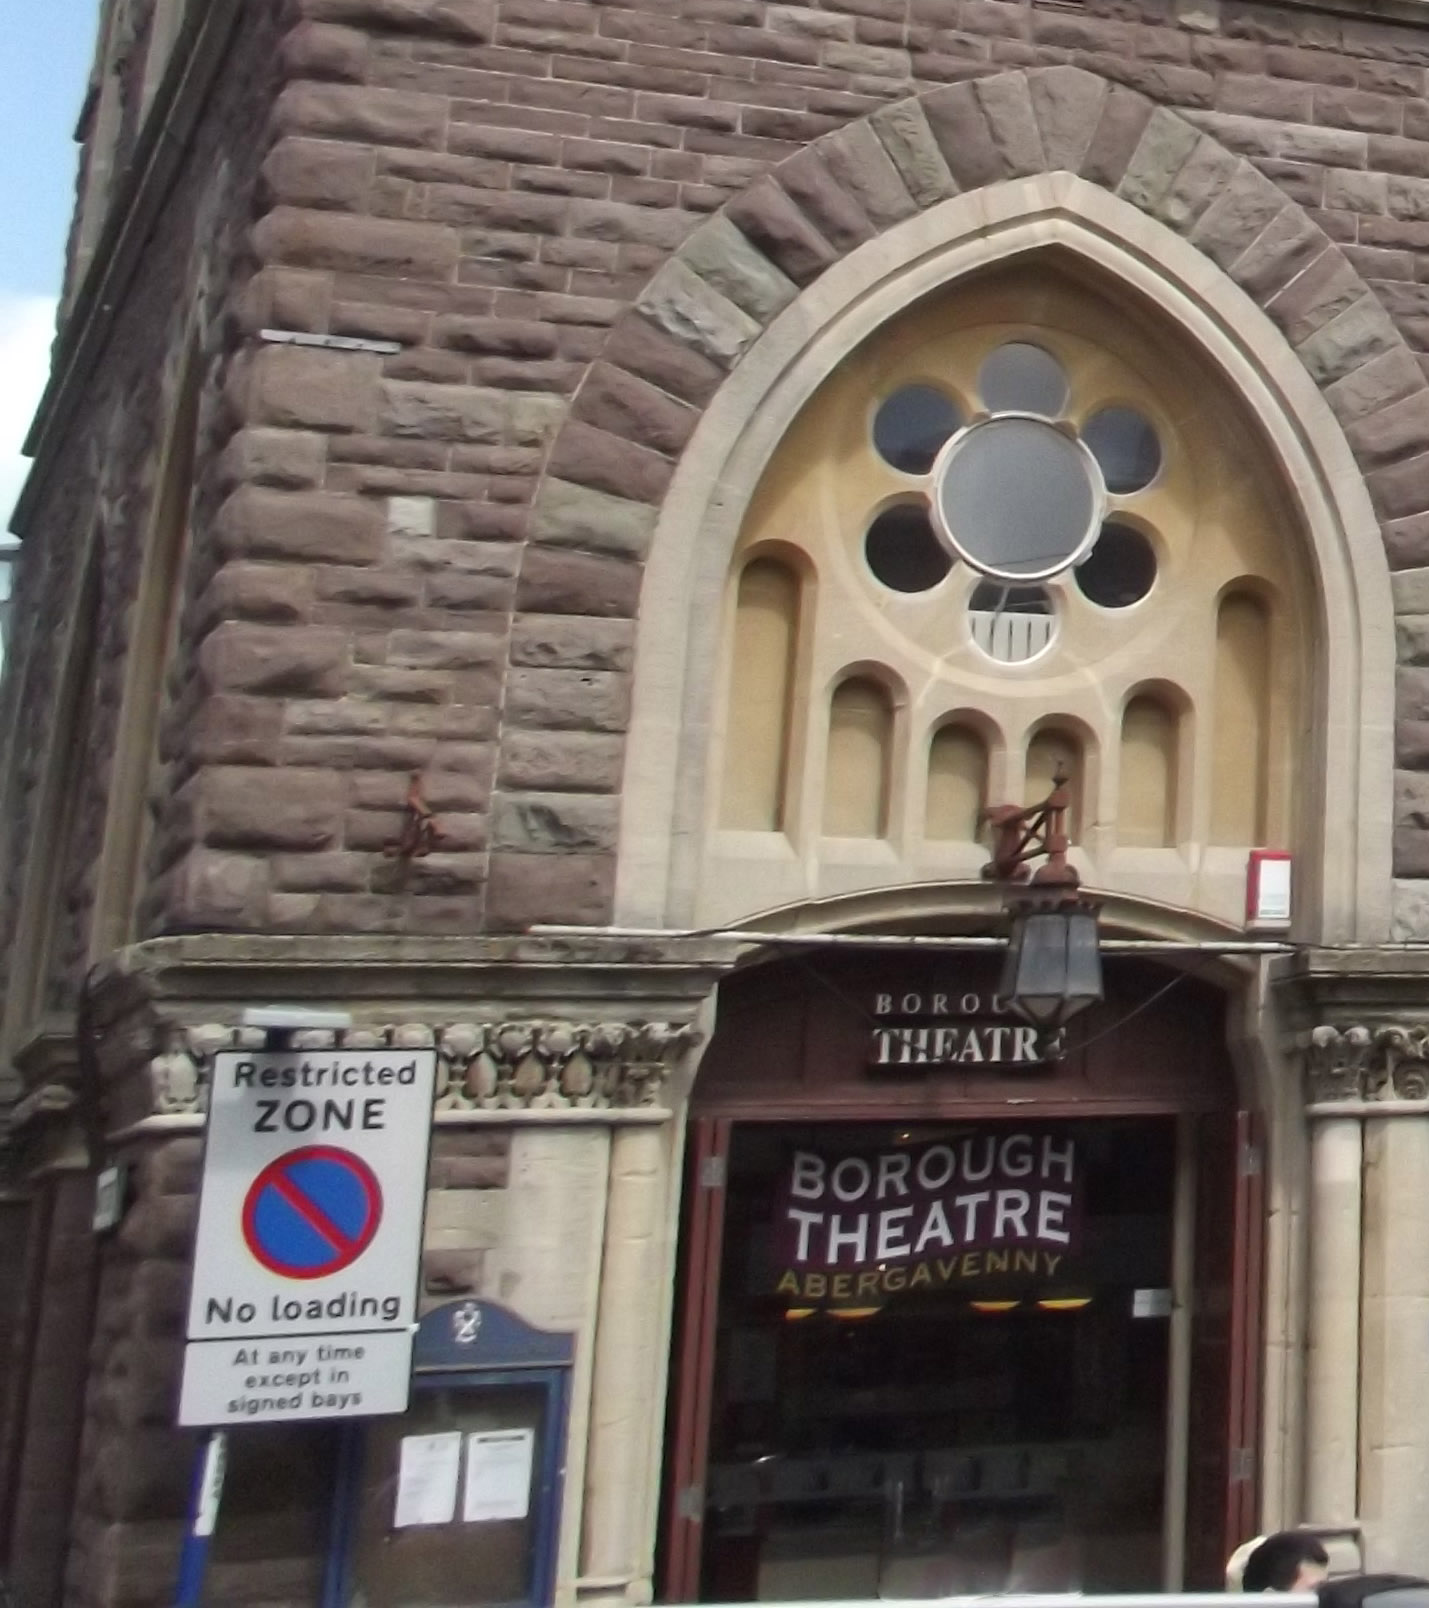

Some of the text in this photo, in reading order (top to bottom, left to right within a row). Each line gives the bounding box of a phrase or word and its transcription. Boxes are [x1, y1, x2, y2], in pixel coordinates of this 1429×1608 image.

[875, 993, 1009, 1015] BOROU
[233, 1059, 417, 1087] Restricted
[254, 1098, 386, 1132] ZONE
[790, 1134, 1076, 1203] BOROUGH
[788, 1188, 1073, 1265] THEATRE
[776, 1247, 1064, 1299] ABERGAVENNY
[205, 1291, 402, 1325] No loading
[232, 1344, 366, 1366] At any time
[244, 1368, 350, 1389] except in
[227, 1391, 363, 1415] signed bays
